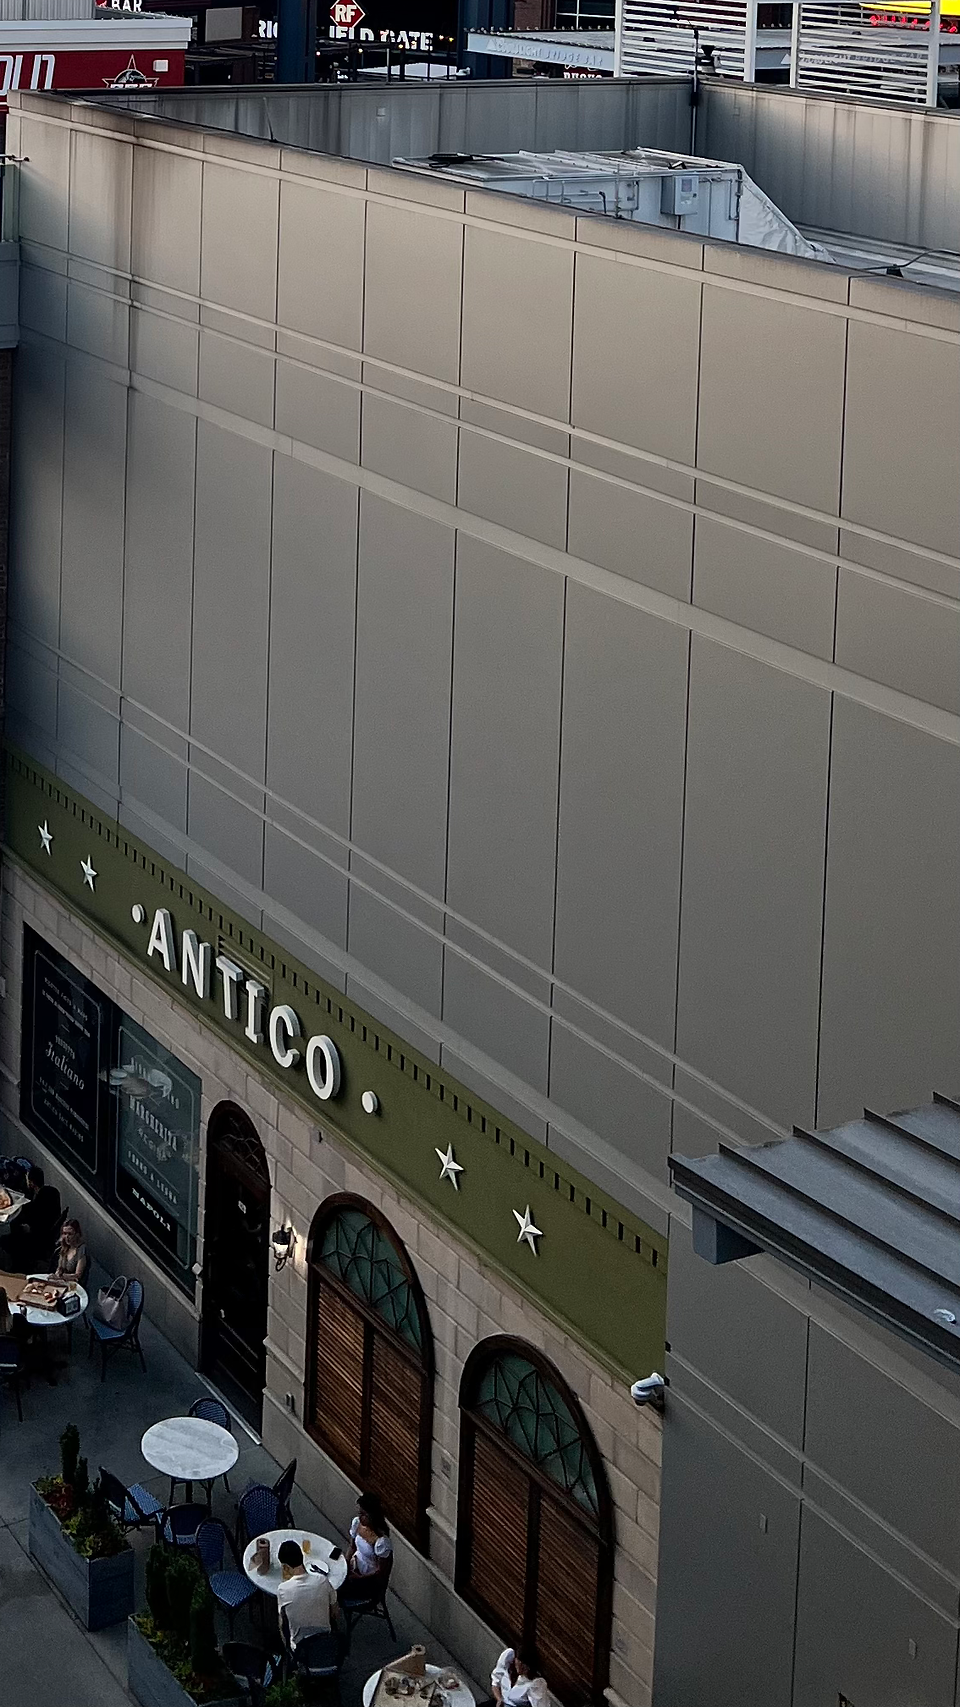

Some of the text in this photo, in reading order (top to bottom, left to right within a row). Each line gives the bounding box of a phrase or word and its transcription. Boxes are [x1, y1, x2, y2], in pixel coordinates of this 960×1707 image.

[335, 4, 357, 23] RF
[147, 907, 341, 1101] ANTICO
[44, 1041, 85, 1091] Italiano
[131, 1187, 171, 1232] NAPOLI
